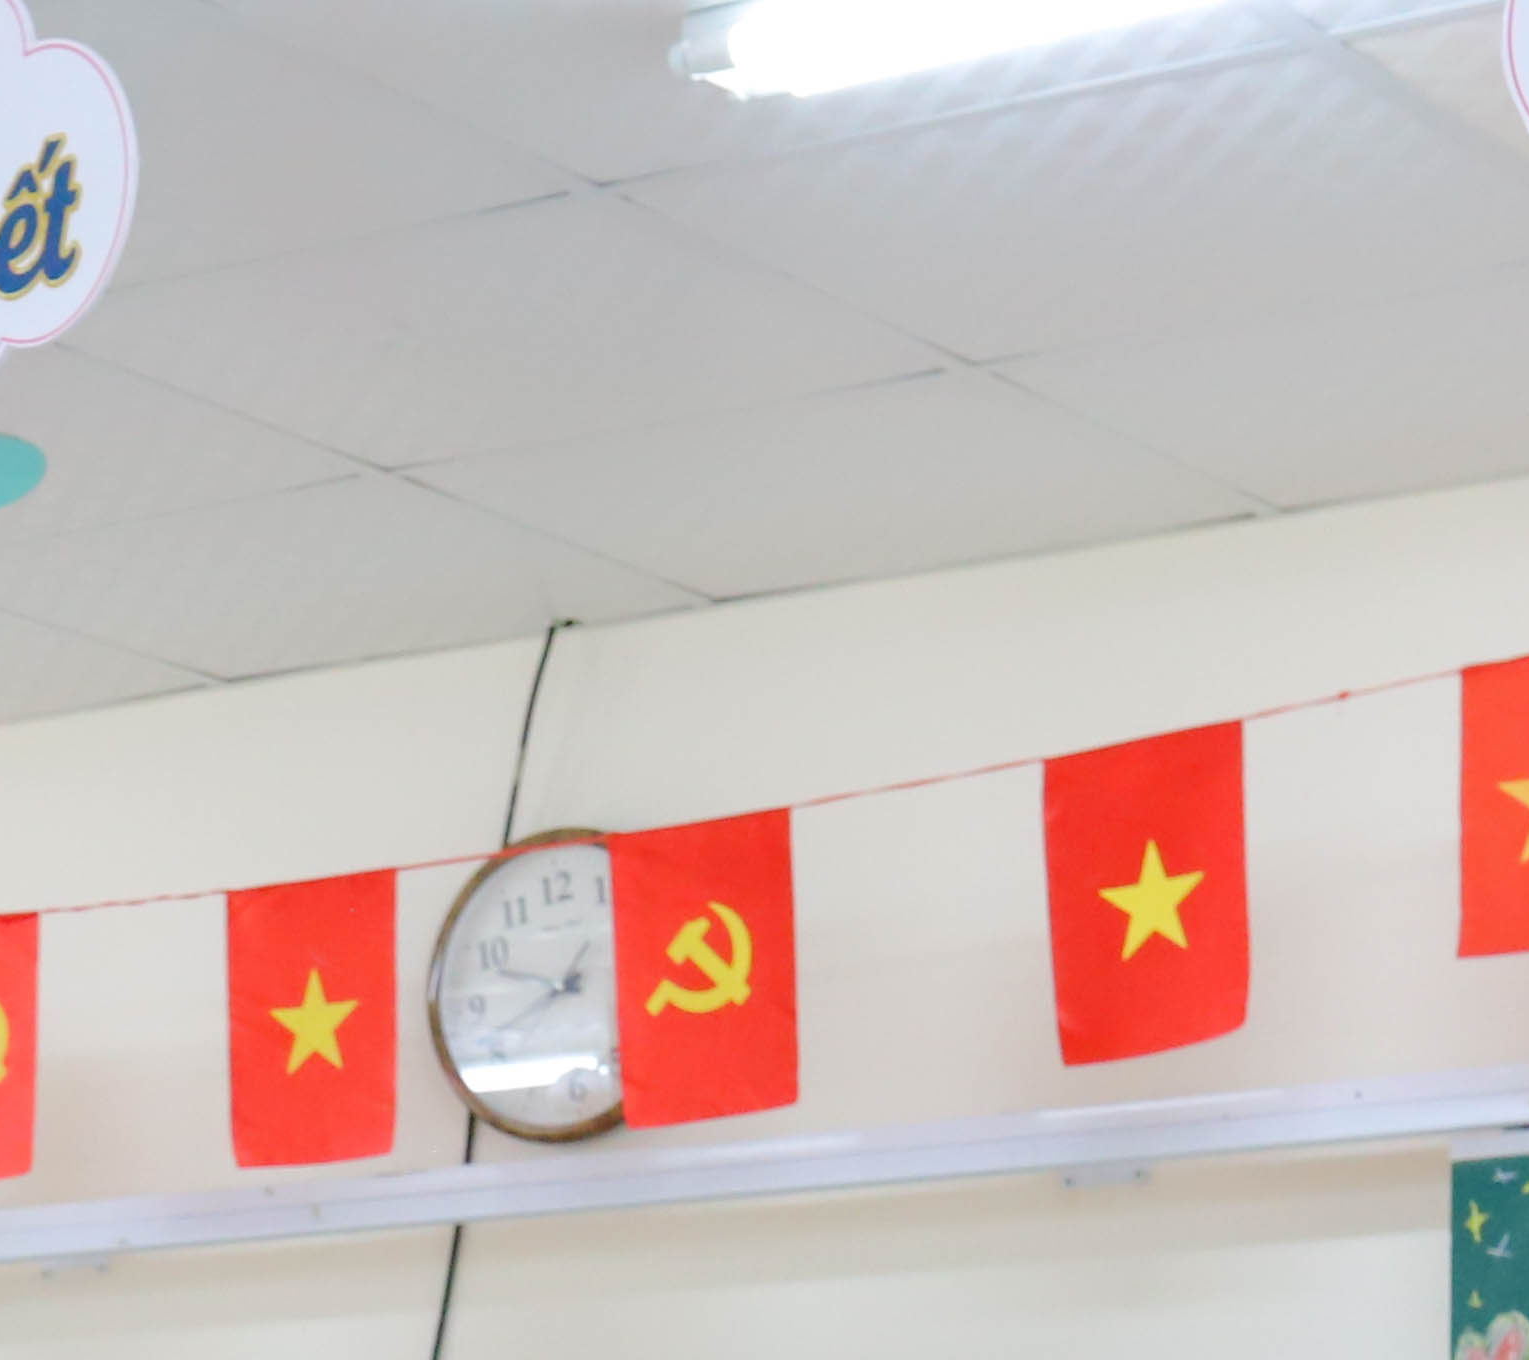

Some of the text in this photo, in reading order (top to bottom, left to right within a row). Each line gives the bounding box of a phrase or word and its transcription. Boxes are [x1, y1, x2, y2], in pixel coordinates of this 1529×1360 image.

[542, 872, 572, 906] 12
[502, 896, 528, 929] 11
[477, 937, 510, 971] 10
[468, 995, 486, 1022] 9
